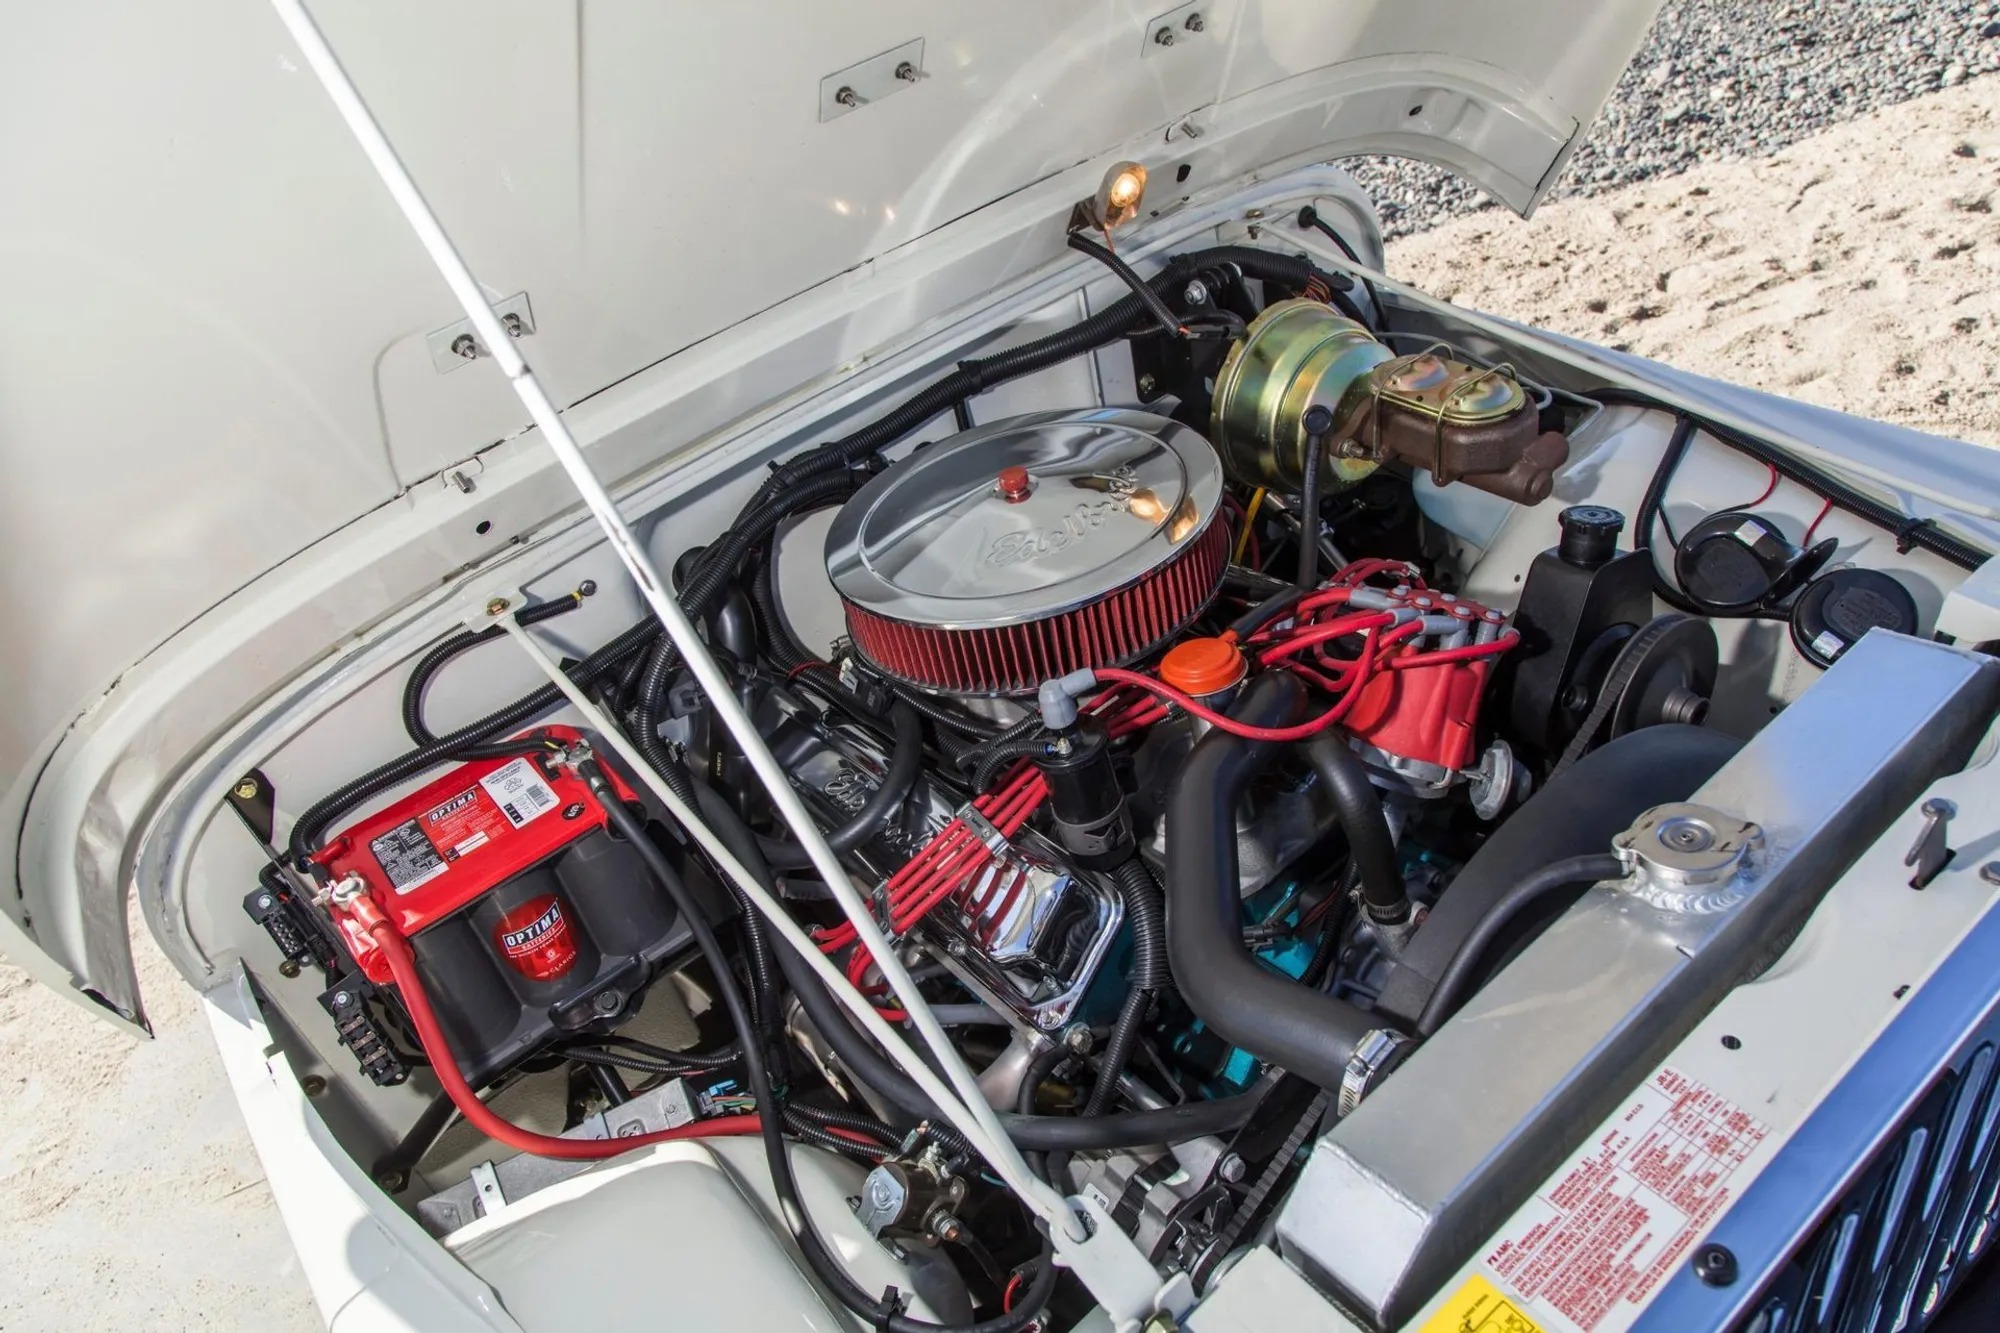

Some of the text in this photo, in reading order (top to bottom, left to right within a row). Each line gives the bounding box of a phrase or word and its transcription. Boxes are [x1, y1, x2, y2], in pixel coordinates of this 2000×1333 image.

[431, 792, 474, 822] OPTIMA
[507, 907, 559, 946] OPTIMA
[1493, 1222, 1543, 1273] VEHICLE EMISSION
[1494, 1239, 1513, 1257] AMC
[1500, 1214, 1561, 1278] CONTROL INFORMATION
[1516, 1262, 1546, 1293] APPLICABLE
[1520, 1255, 1541, 1276] VEHICLE
